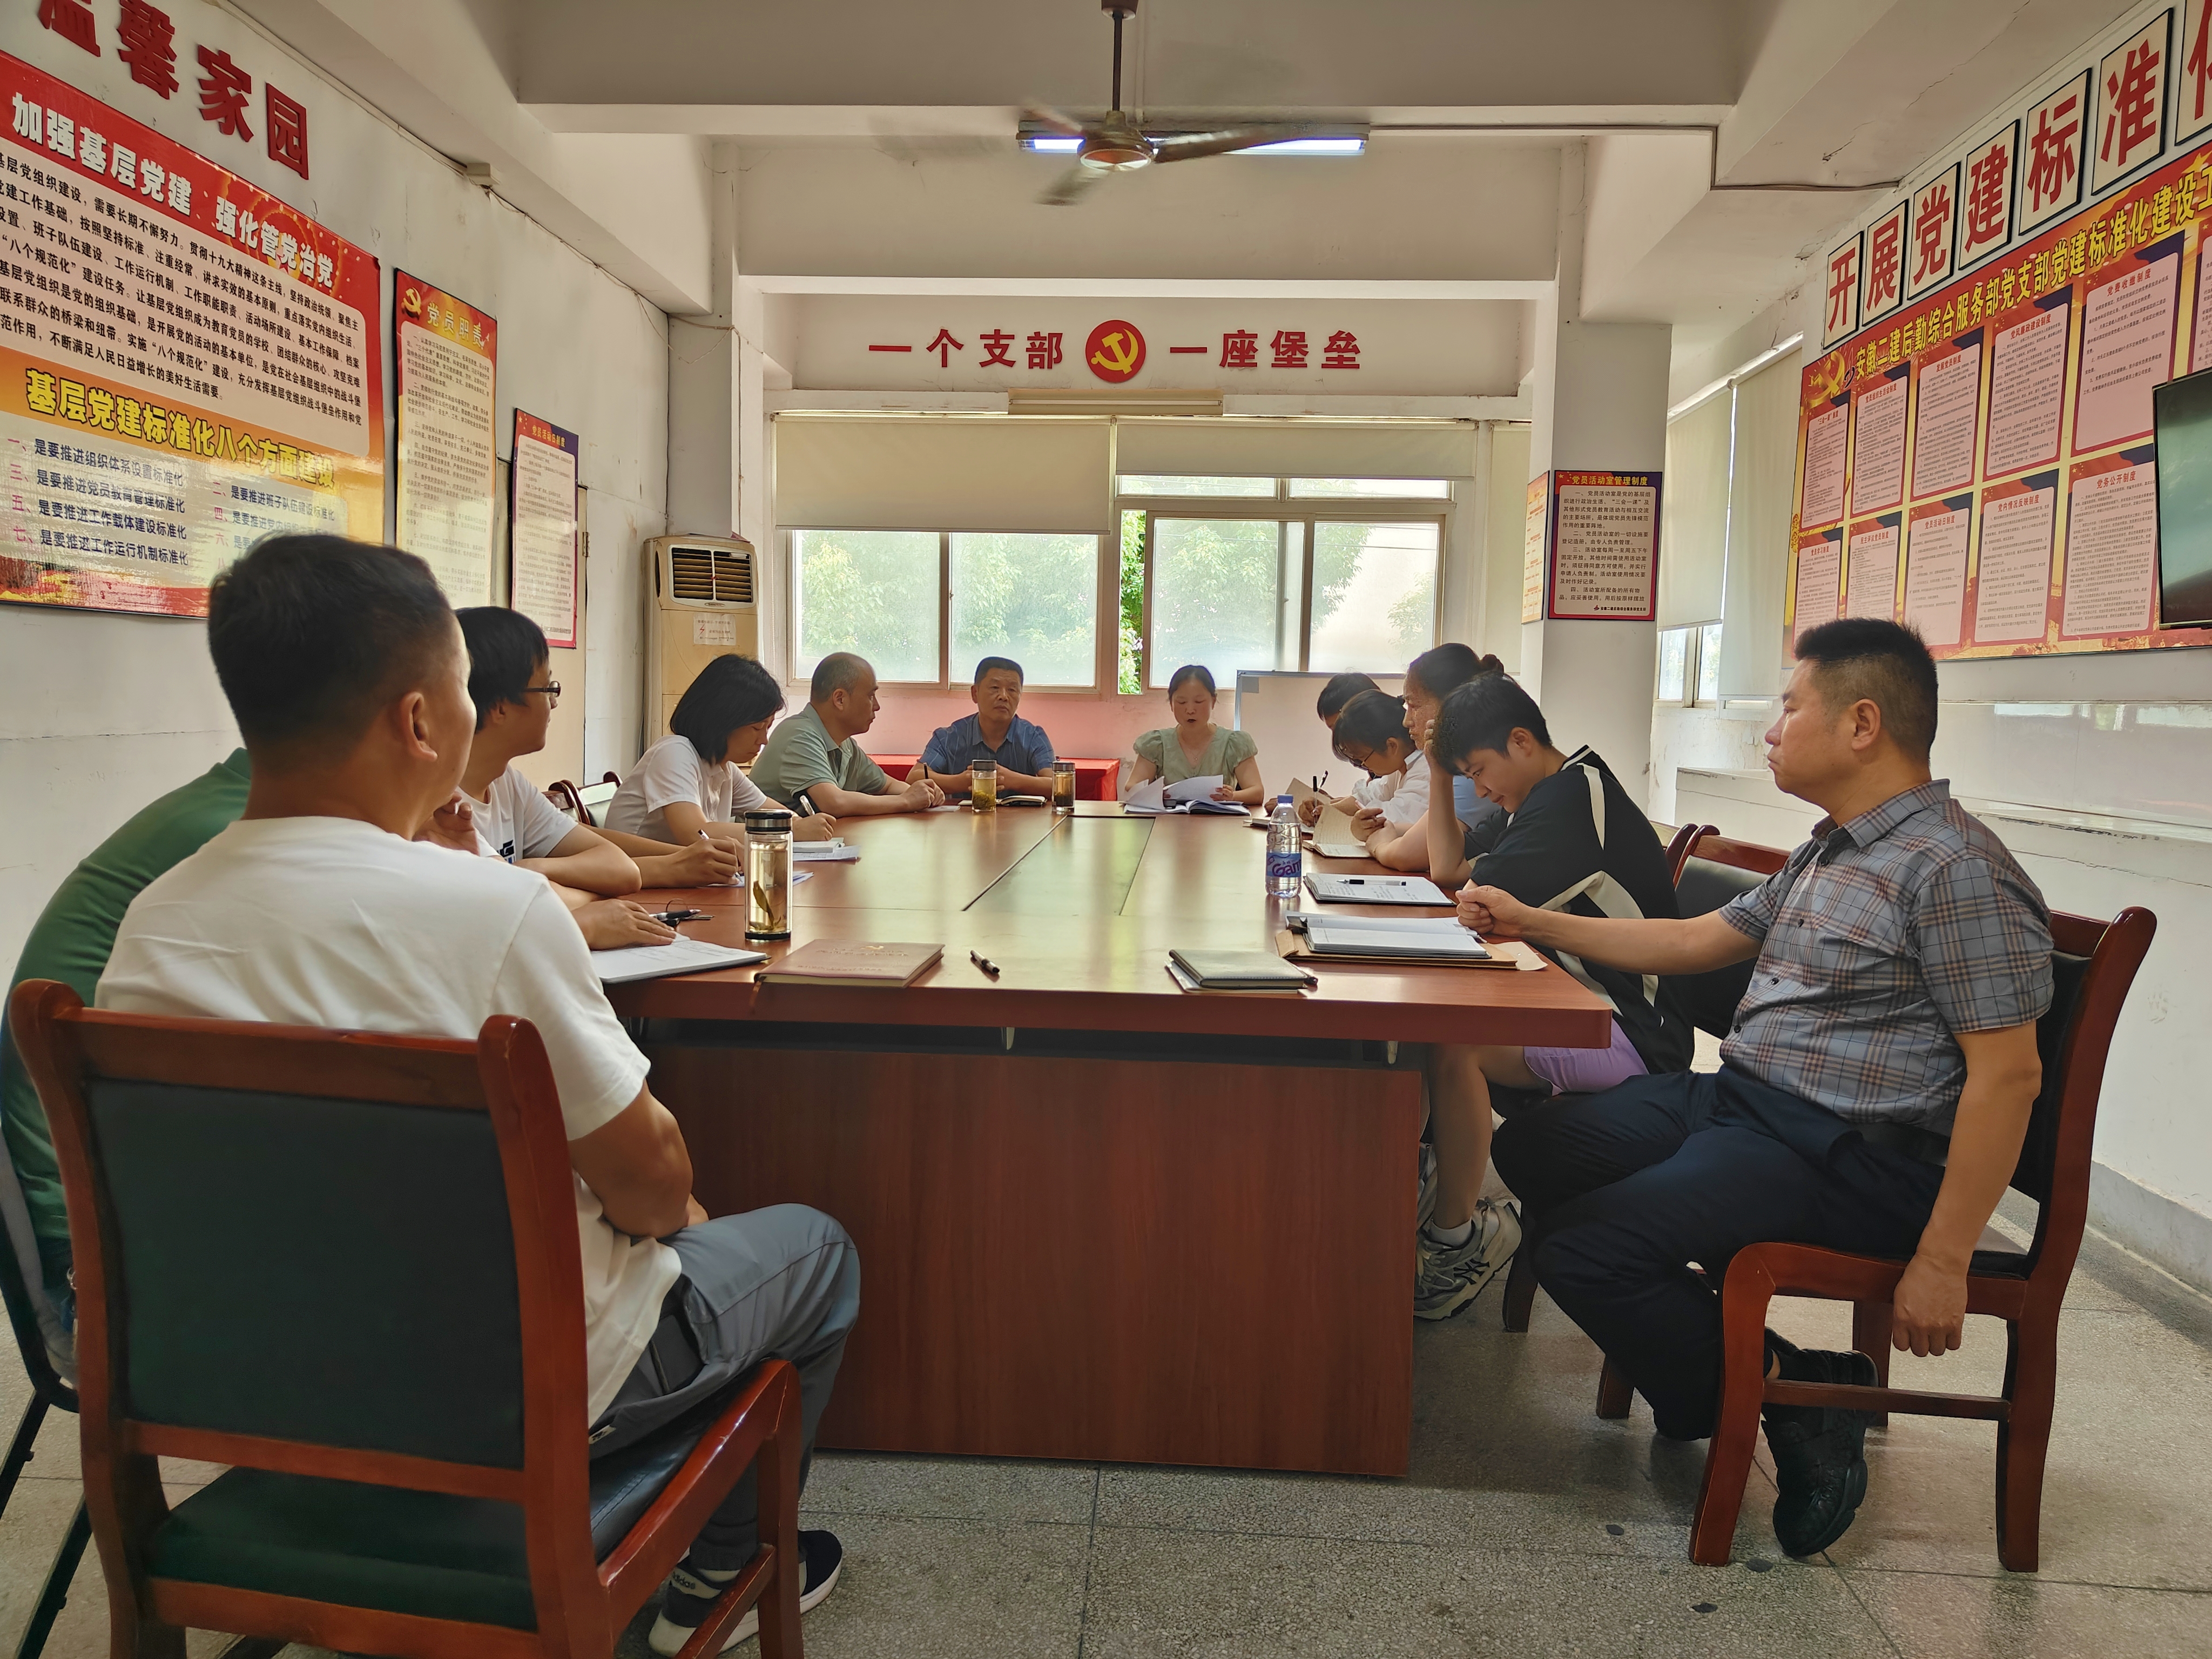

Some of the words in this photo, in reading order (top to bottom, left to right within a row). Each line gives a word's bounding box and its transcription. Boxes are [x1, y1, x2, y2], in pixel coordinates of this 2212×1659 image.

[12, 92, 192, 217] 加强基层党建
[215, 196, 334, 288] 强化管党治党
[2107, 268, 2152, 297] 党费收缴制度
[427, 301, 483, 349] 党员职责
[2010, 313, 2051, 340] 党风廉政建设制度
[868, 329, 1063, 370] 一个支部
[1170, 329, 1361, 370] 一座堡垒
[25, 368, 335, 489] 基层党建标准化八个方面建设
[1572, 475, 1649, 486] 党员活动室管理制度
[2096, 470, 2136, 489] 党务公开制度
[1998, 494, 2040, 512] 党内情况反映制度
